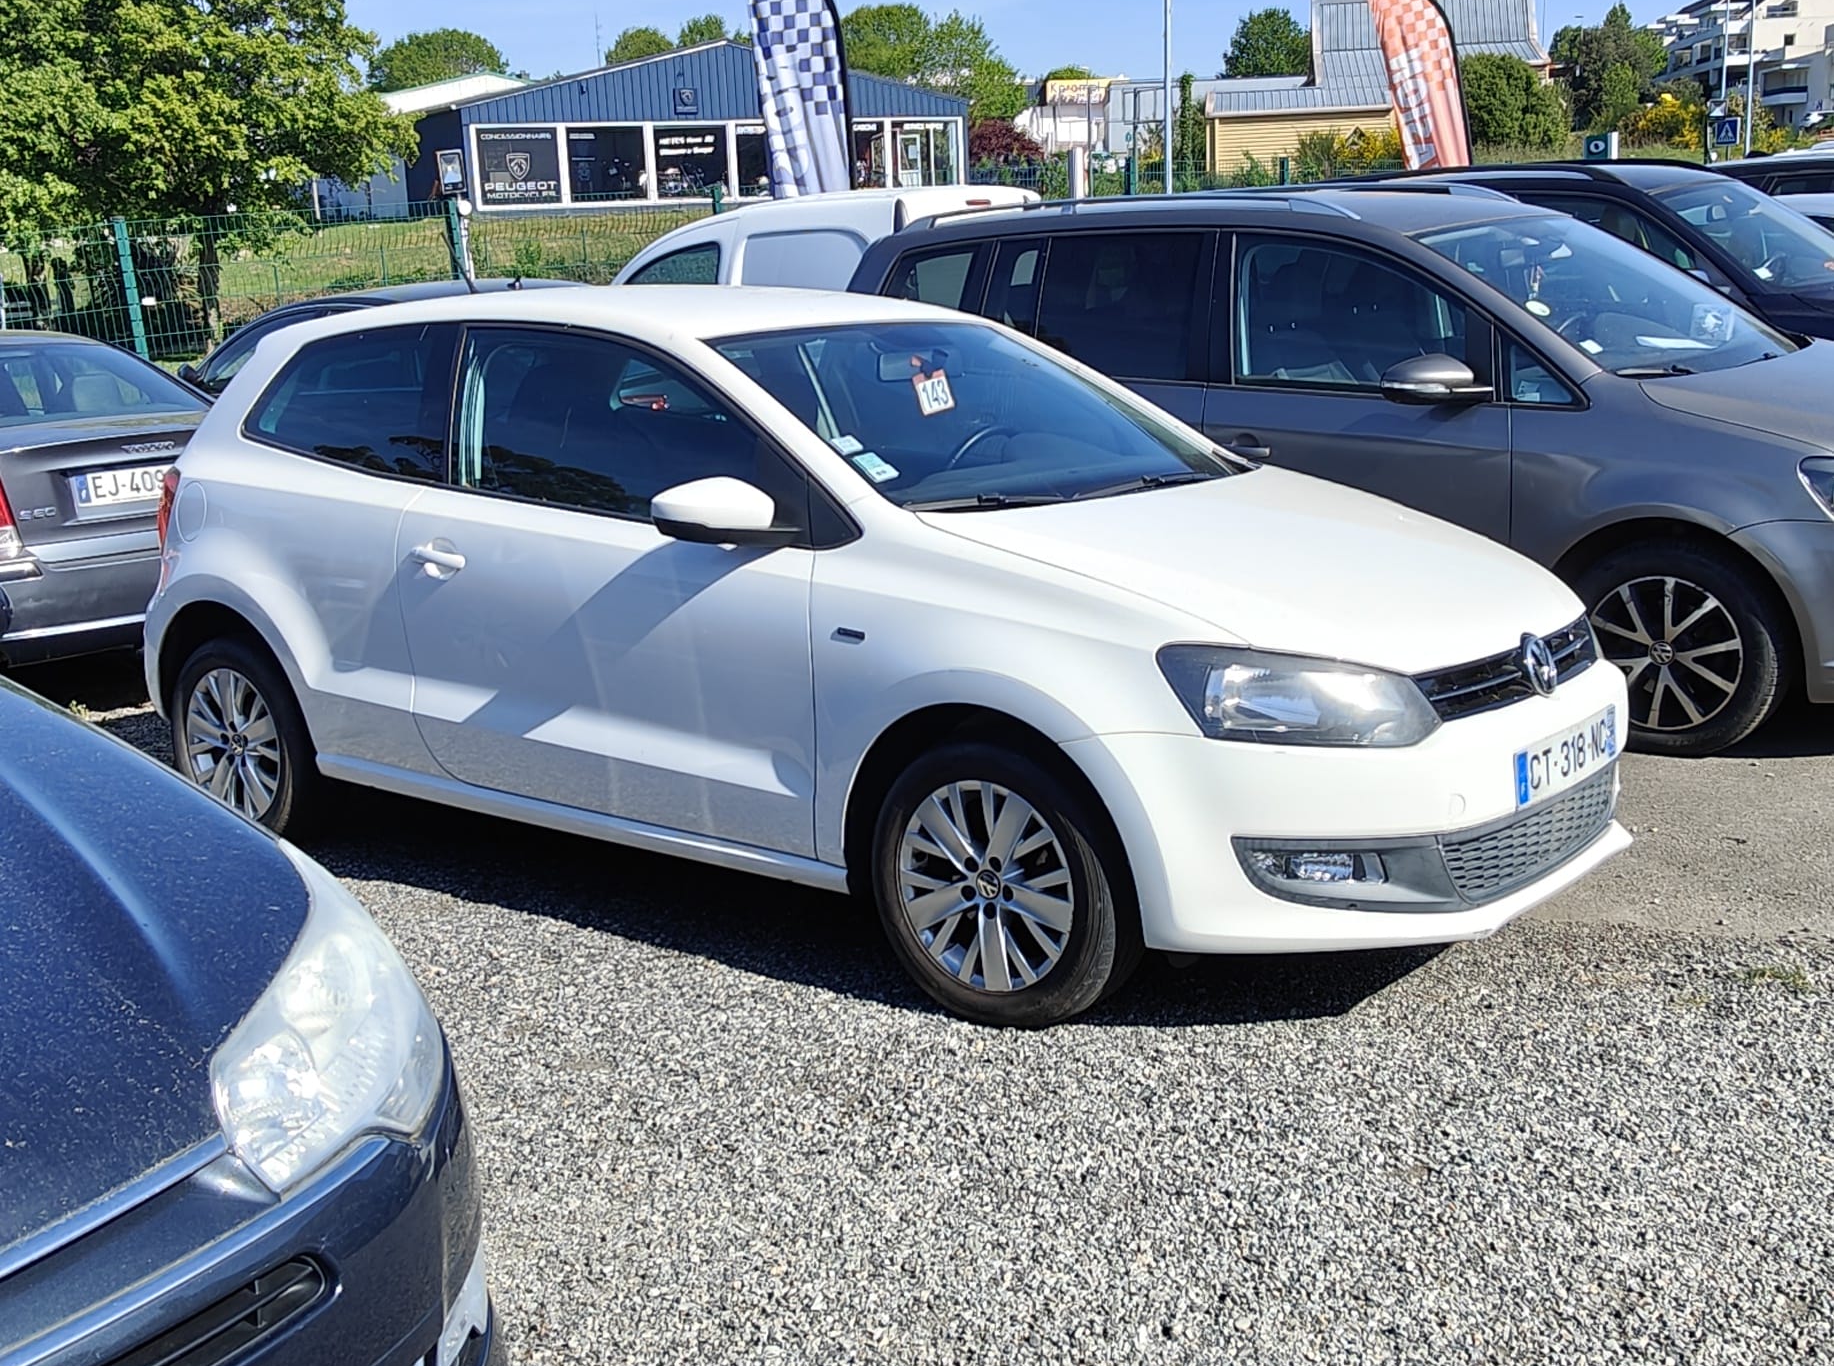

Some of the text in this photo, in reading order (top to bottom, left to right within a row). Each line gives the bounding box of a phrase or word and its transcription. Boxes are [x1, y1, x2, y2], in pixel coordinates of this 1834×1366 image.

[484, 181, 558, 192] PEUGEOT
[922, 379, 949, 408] 143
[1530, 718, 1607, 790] CT-318-NC
